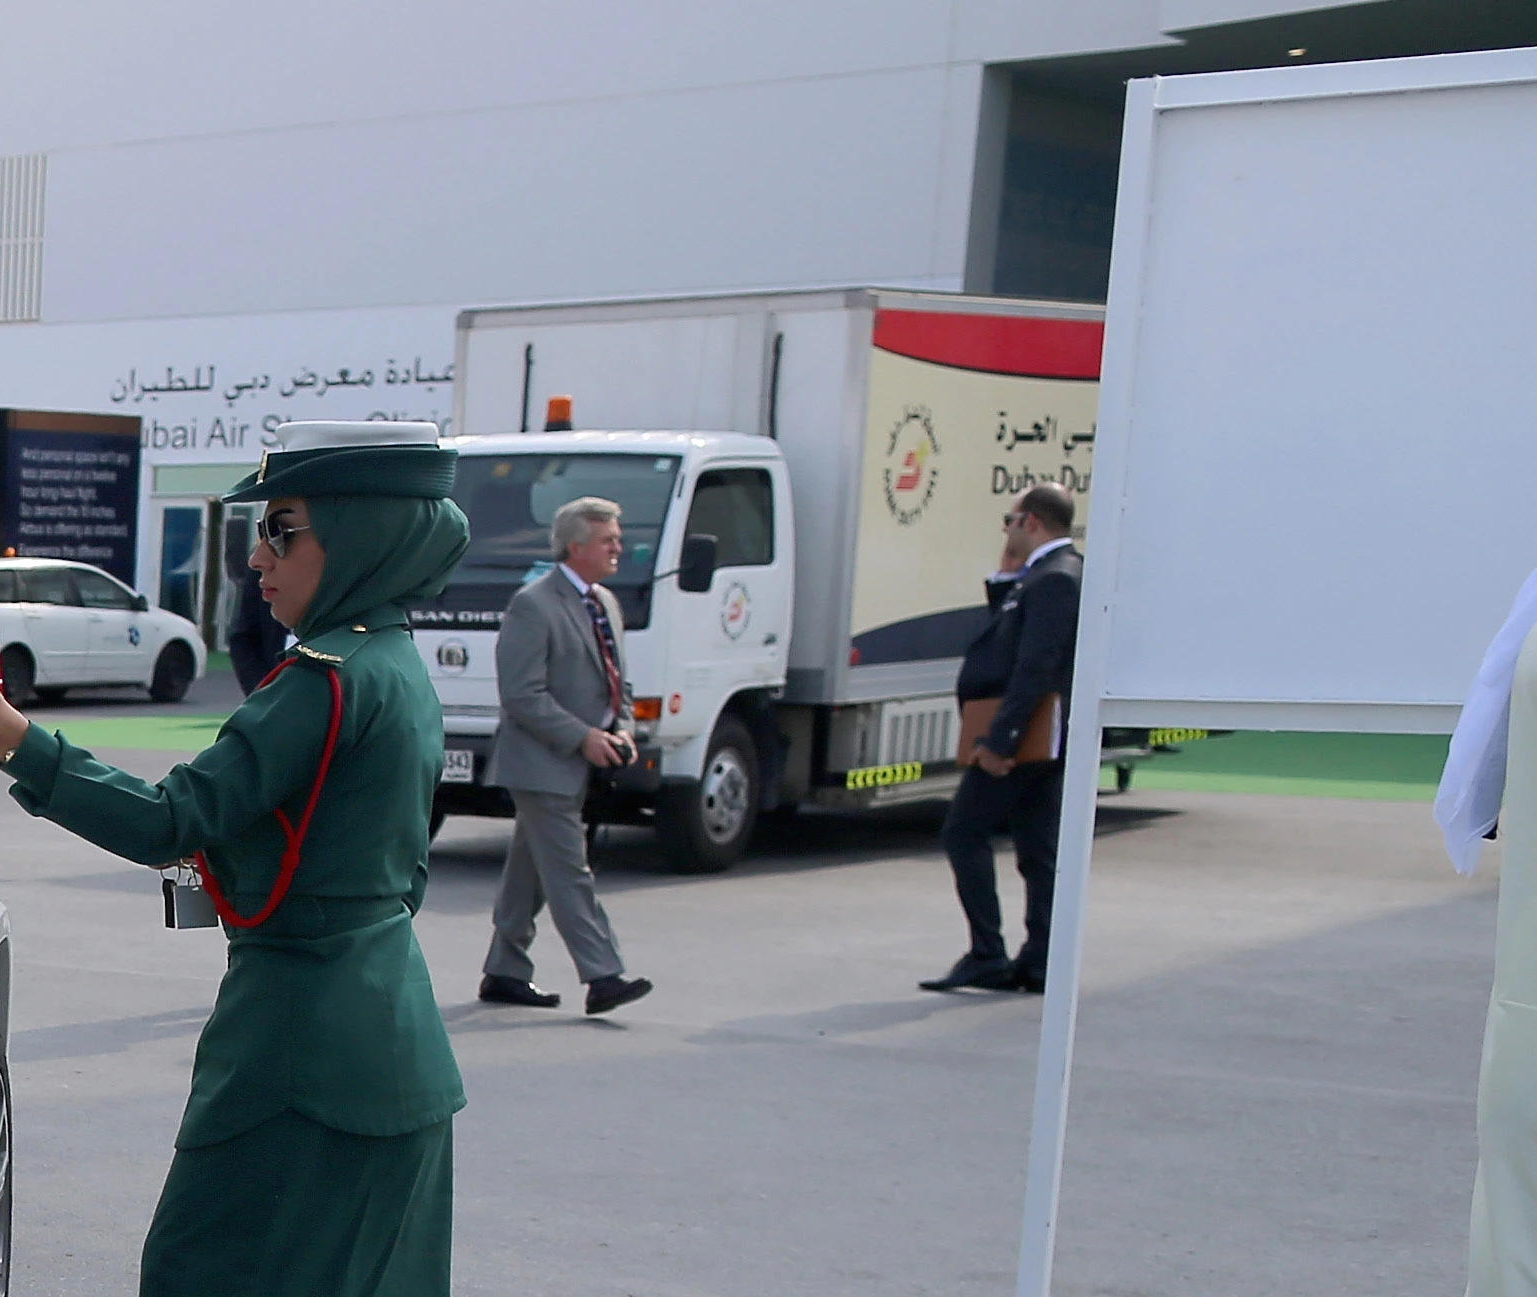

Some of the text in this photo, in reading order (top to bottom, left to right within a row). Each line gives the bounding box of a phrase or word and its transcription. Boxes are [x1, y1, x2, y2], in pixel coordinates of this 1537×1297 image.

[110, 357, 453, 407] عيادة معرض دبي للطيران
[142, 420, 197, 449] ubai
[205, 417, 251, 448] Air
[1062, 422, 1098, 458] بي
